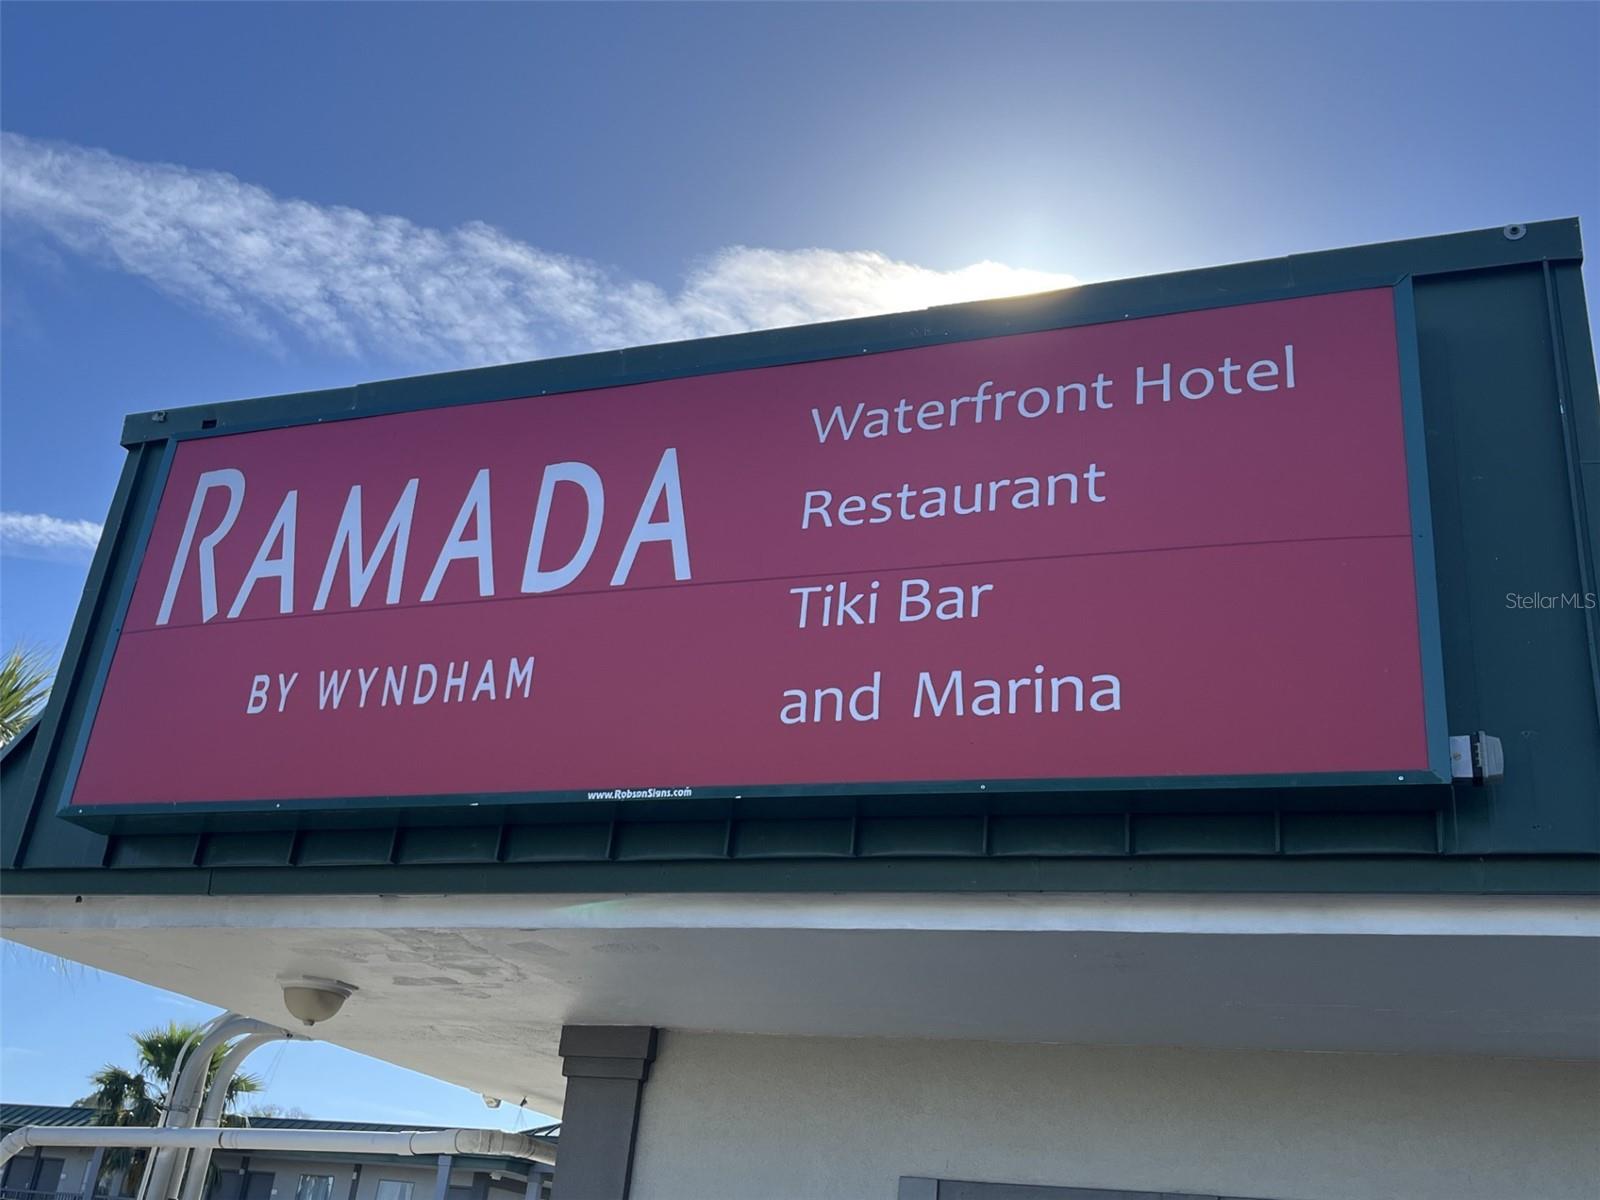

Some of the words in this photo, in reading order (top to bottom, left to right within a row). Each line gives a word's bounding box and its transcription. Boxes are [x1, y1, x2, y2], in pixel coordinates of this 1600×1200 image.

[811, 373, 1113, 443] Waterfront
[1136, 344, 1295, 405] Hotel
[801, 463, 1106, 530] Restaurant
[155, 447, 692, 626] RAMADA
[789, 580, 880, 629] Tiki
[899, 578, 994, 622] Bar
[246, 672, 299, 714] BY
[319, 656, 535, 710] WYNDHAM
[780, 670, 881, 725] and
[913, 664, 1121, 718] Marina
[587, 787, 692, 800] www.RobsonSigns.com
